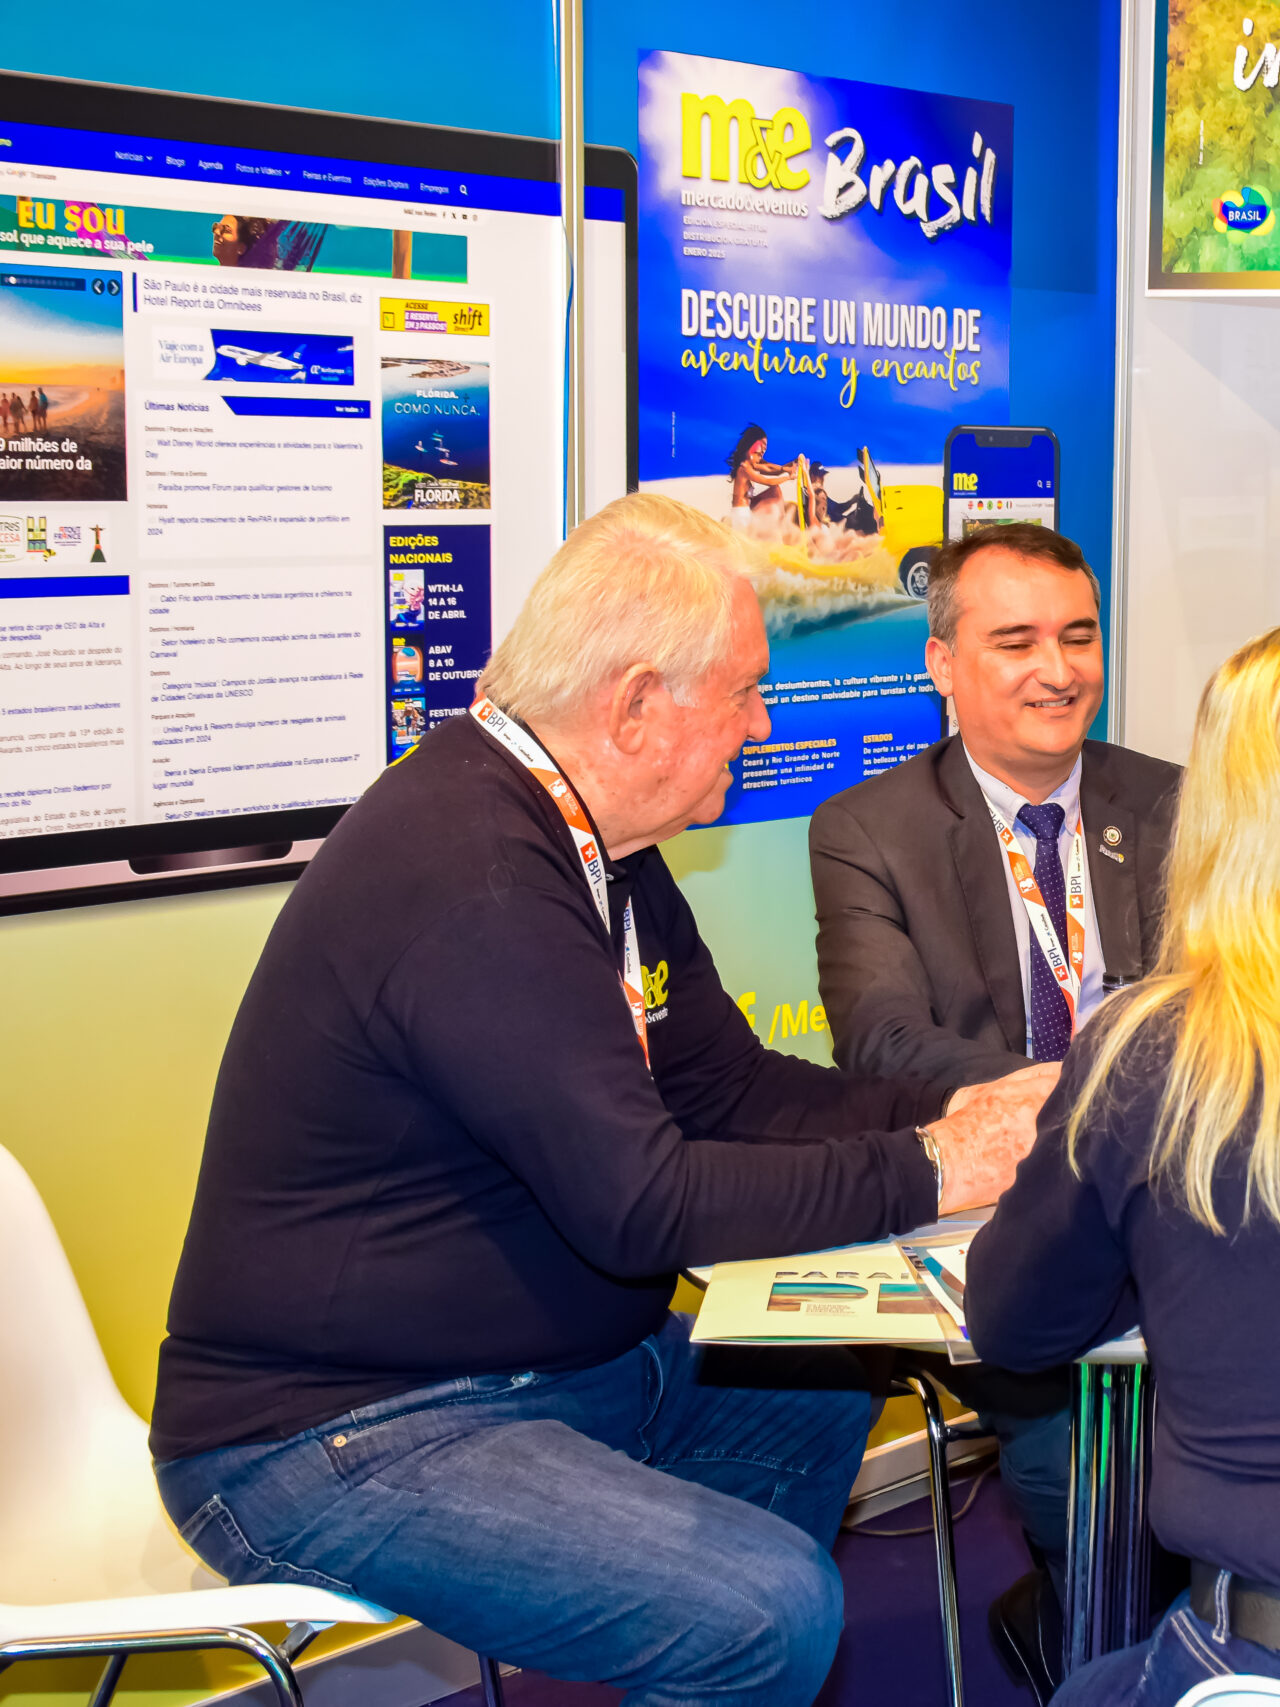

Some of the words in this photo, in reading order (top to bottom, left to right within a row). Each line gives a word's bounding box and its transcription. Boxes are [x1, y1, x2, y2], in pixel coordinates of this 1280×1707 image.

[817, 127, 996, 239] Brasil
[18, 200, 56, 230] EU
[64, 204, 125, 235] SOU
[1228, 210, 1262, 221] BRASIL
[0, 229, 19, 243] sol
[20, 234, 45, 248] que
[46, 235, 93, 250] aquece
[94, 239, 102, 248] a
[104, 239, 126, 251] sua
[129, 241, 154, 254] pele
[683, 247, 708, 258] ENERO
[143, 279, 161, 291] São
[165, 280, 190, 293] Paulo
[193, 283, 199, 293] é
[202, 286, 208, 294] a
[210, 284, 239, 296] cidade
[241, 286, 262, 297] mais
[264, 288, 307, 300] reservada
[309, 292, 320, 300] no
[350, 293, 362, 304] diz
[144, 296, 168, 307] Hotel
[170, 297, 201, 310] Report
[204, 299, 215, 309] da
[218, 299, 262, 312] Omnibees
[453, 306, 483, 330] shift
[681, 288, 817, 344] DESCUBRE
[822, 299, 856, 345] UN
[863, 302, 947, 350] MUNDO
[952, 308, 981, 352] DE
[681, 337, 829, 384] aventuras
[840, 354, 860, 409] y
[871, 348, 981, 392] encantos
[144, 400, 175, 411] Últimas
[178, 402, 209, 412] Notícias
[395, 402, 431, 414] COMO
[434, 404, 480, 416] NUNCA.
[8, 437, 59, 453] milhões
[61, 438, 78, 452] de
[25, 455, 74, 470] número
[76, 456, 93, 470] da
[415, 488, 460, 502] FLORIDA
[389, 534, 439, 550] EDIÇÕES
[389, 552, 453, 565] NACIONAIS
[428, 584, 464, 593] WTM-LA
[428, 597, 437, 606] 14
[439, 598, 446, 606] A
[447, 597, 457, 606] 16
[428, 611, 440, 620] DE
[442, 610, 467, 619] ABRIL
[428, 645, 452, 655] ABAV
[436, 659, 443, 667] A
[444, 658, 454, 667] 10
[429, 671, 440, 681] DE
[442, 669, 483, 680] OUTUBRO
[834, 677, 841, 686] la
[843, 676, 867, 686] cultura
[870, 674, 898, 684] vibrante
[906, 673, 912, 681] la
[792, 692, 819, 703] destino
[862, 689, 878, 699] para
[880, 686, 906, 696] turistas
[908, 685, 916, 693] de
[918, 684, 934, 692] todo
[429, 708, 467, 718] FESTURIS
[486, 712, 508, 732] BPI
[863, 733, 893, 743] ESTADOS
[743, 743, 794, 755] SUPLEMENTOS
[795, 738, 837, 750] ESPECIALES
[785, 753, 809, 762] Grande
[822, 751, 840, 759] Norte
[743, 769, 778, 779] presentan
[795, 763, 824, 772] infinidad
[743, 780, 778, 789] atractivos
[587, 859, 603, 885] BPI
[1070, 876, 1082, 894] BPI
[1047, 946, 1063, 967] BPI
